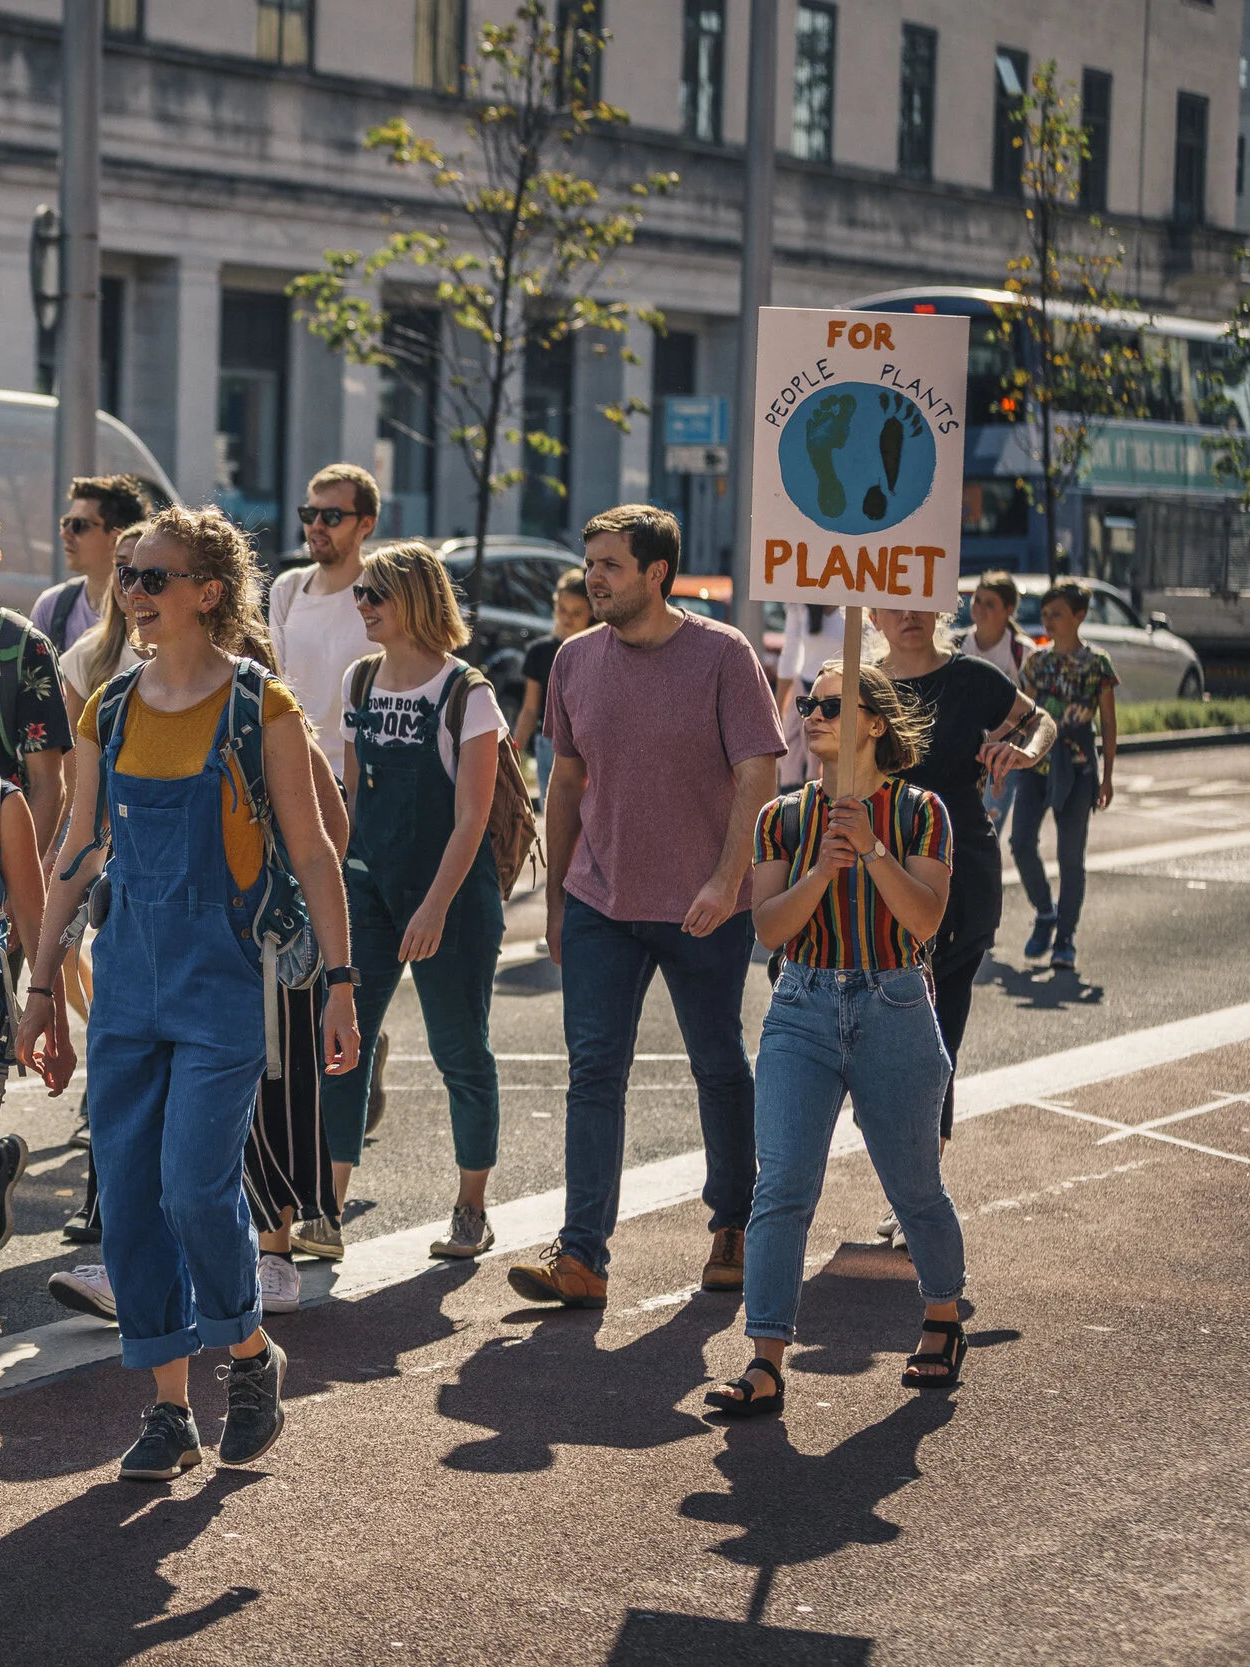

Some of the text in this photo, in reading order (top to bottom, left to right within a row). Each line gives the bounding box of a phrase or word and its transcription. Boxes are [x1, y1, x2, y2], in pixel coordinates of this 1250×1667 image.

[827, 321, 895, 350] FOR
[765, 358, 959, 434] PEOPLE PLANTS
[765, 539, 946, 597] PLANET
